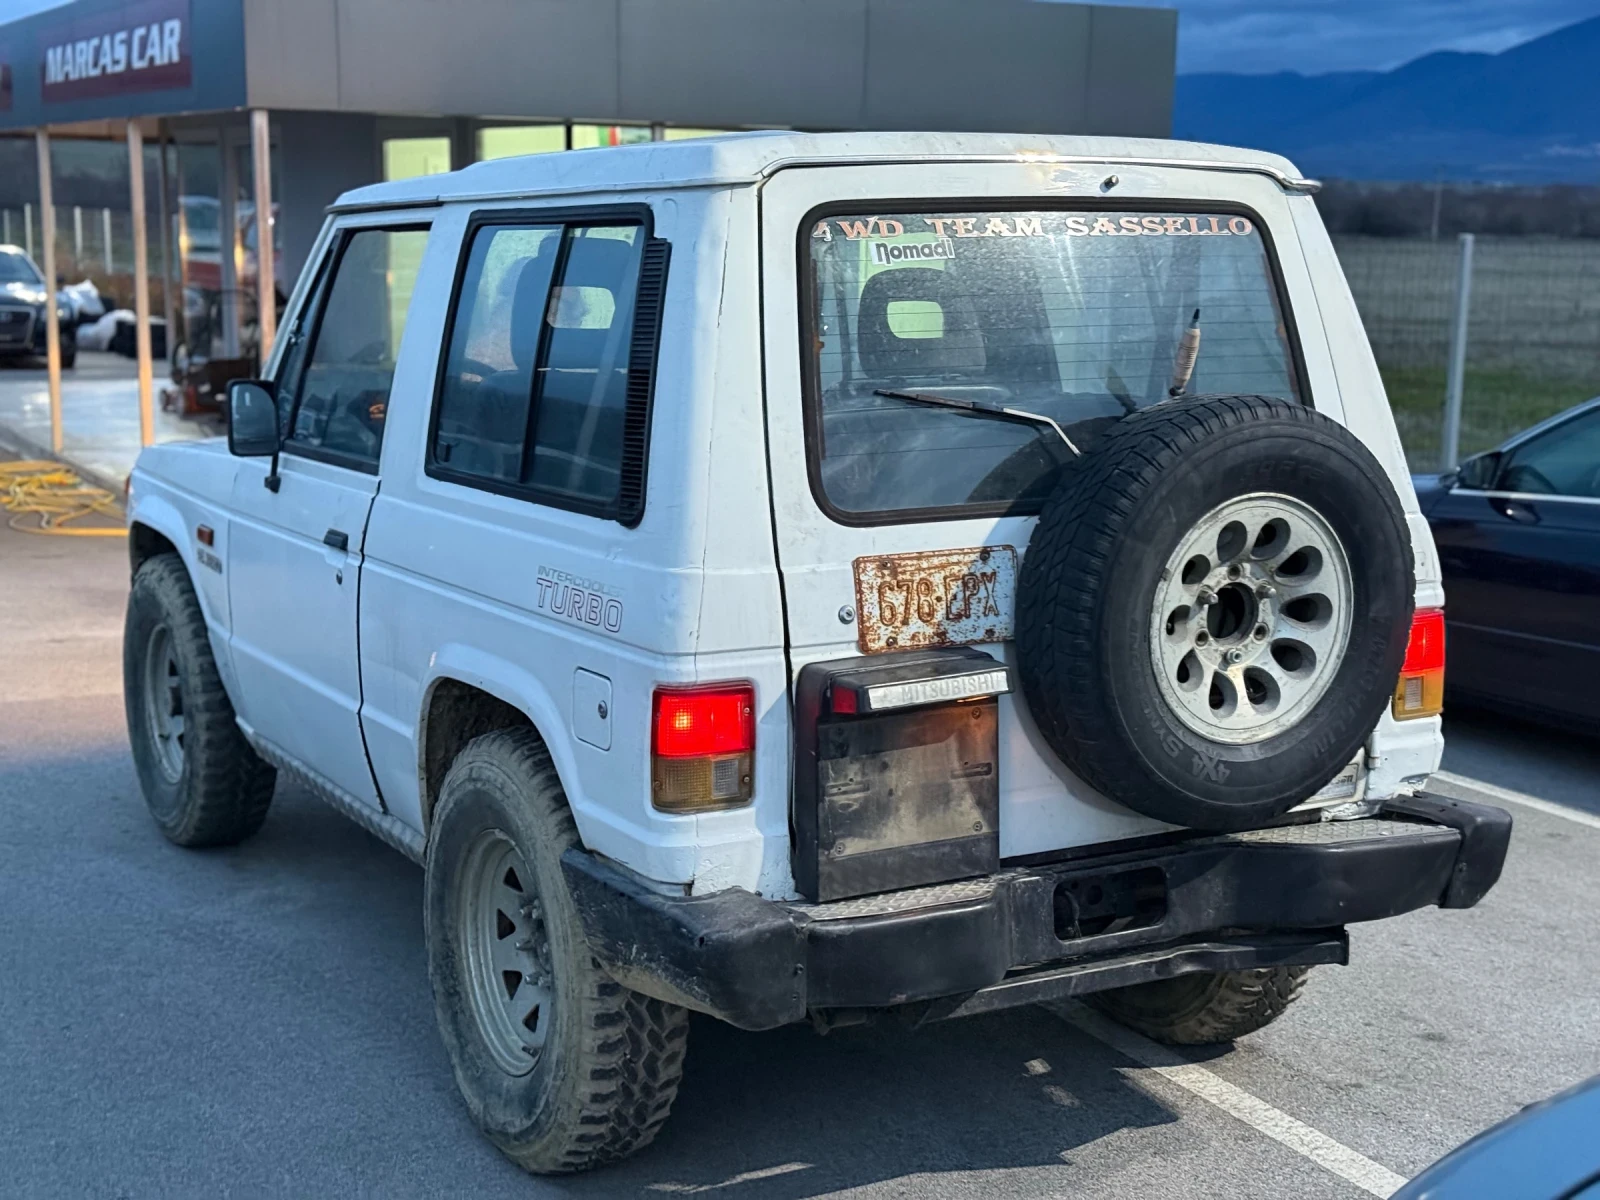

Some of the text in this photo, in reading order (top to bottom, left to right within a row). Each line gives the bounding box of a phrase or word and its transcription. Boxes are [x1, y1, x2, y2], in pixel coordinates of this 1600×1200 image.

[45, 18, 182, 85] MARCAS CAR
[836, 216, 904, 240] WD
[923, 217, 1046, 238] TEAM
[1065, 216, 1253, 237] SASSELLO
[536, 577, 623, 633] TURBO
[900, 674, 996, 702] MITSUBISHI
